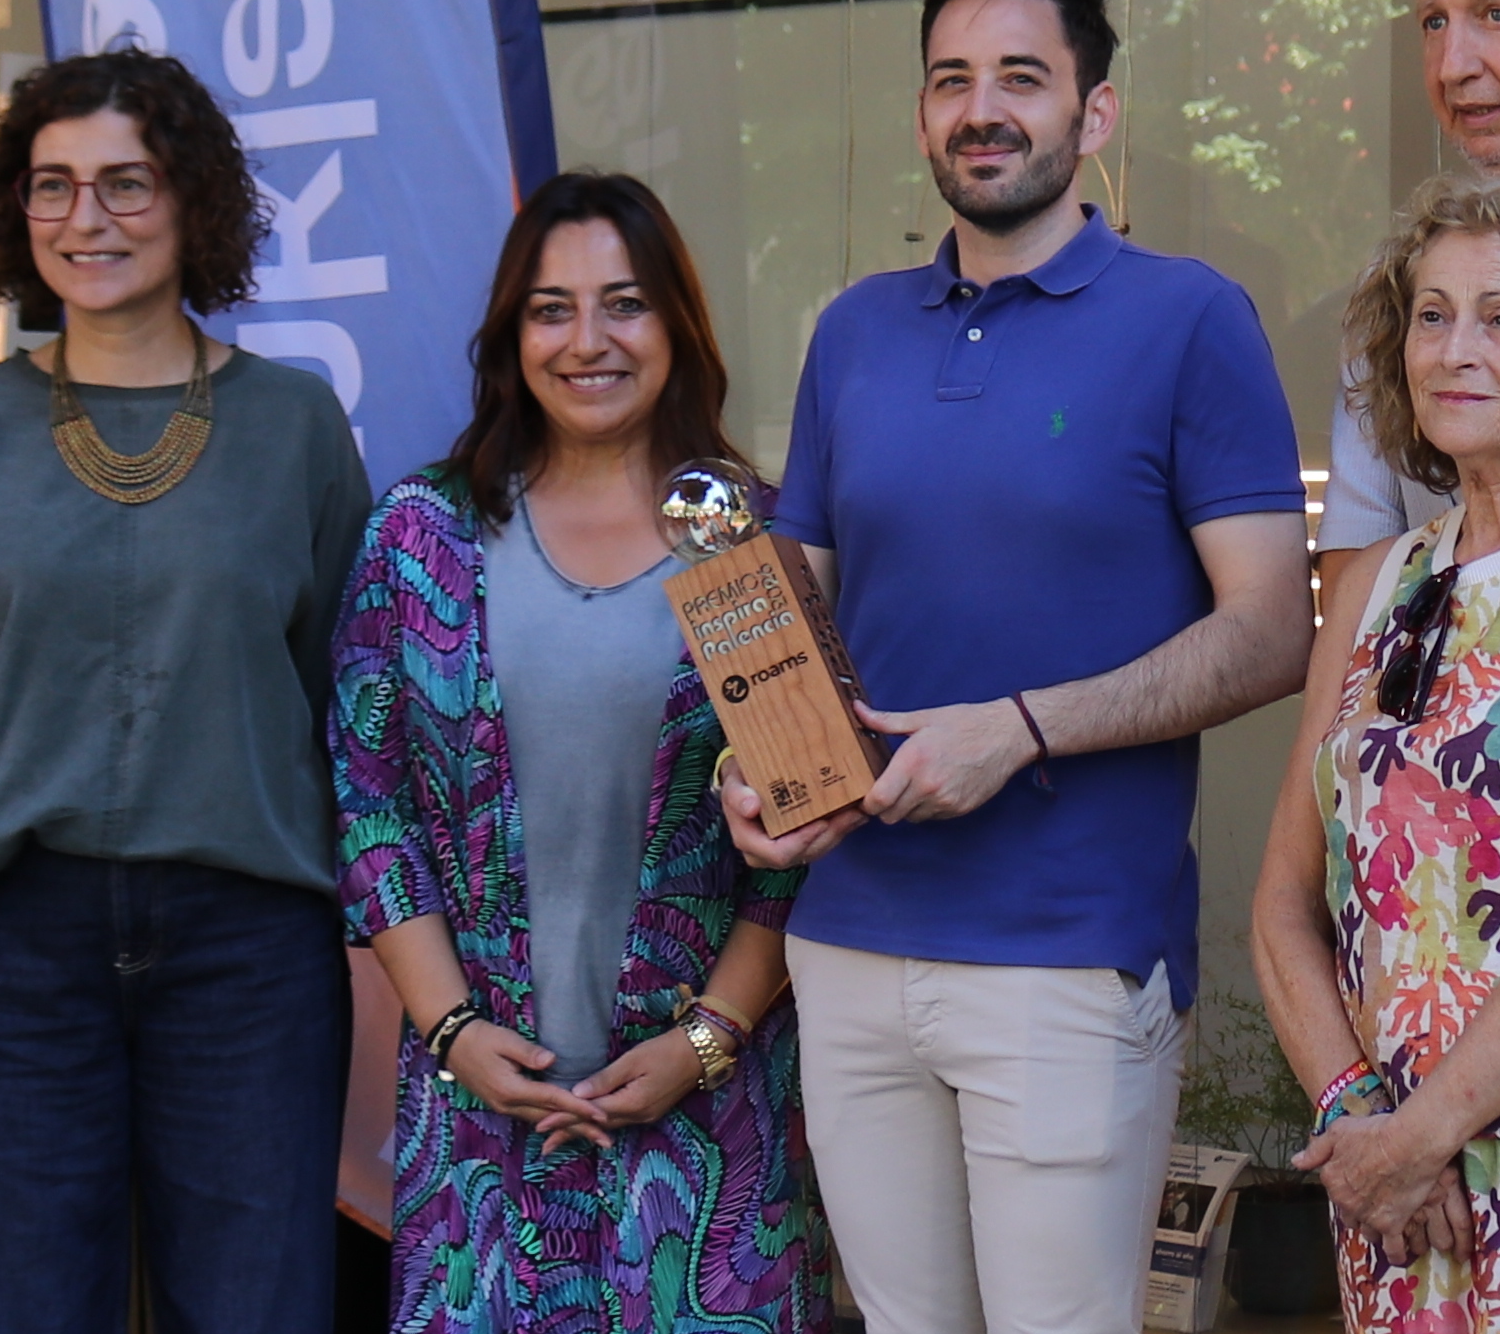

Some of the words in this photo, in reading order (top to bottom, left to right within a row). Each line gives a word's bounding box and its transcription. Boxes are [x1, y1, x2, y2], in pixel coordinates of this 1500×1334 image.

[682, 573, 759, 621] PREMIO
[690, 596, 768, 641] inspira
[702, 610, 796, 662] Palencia
[750, 651, 808, 685] roams
